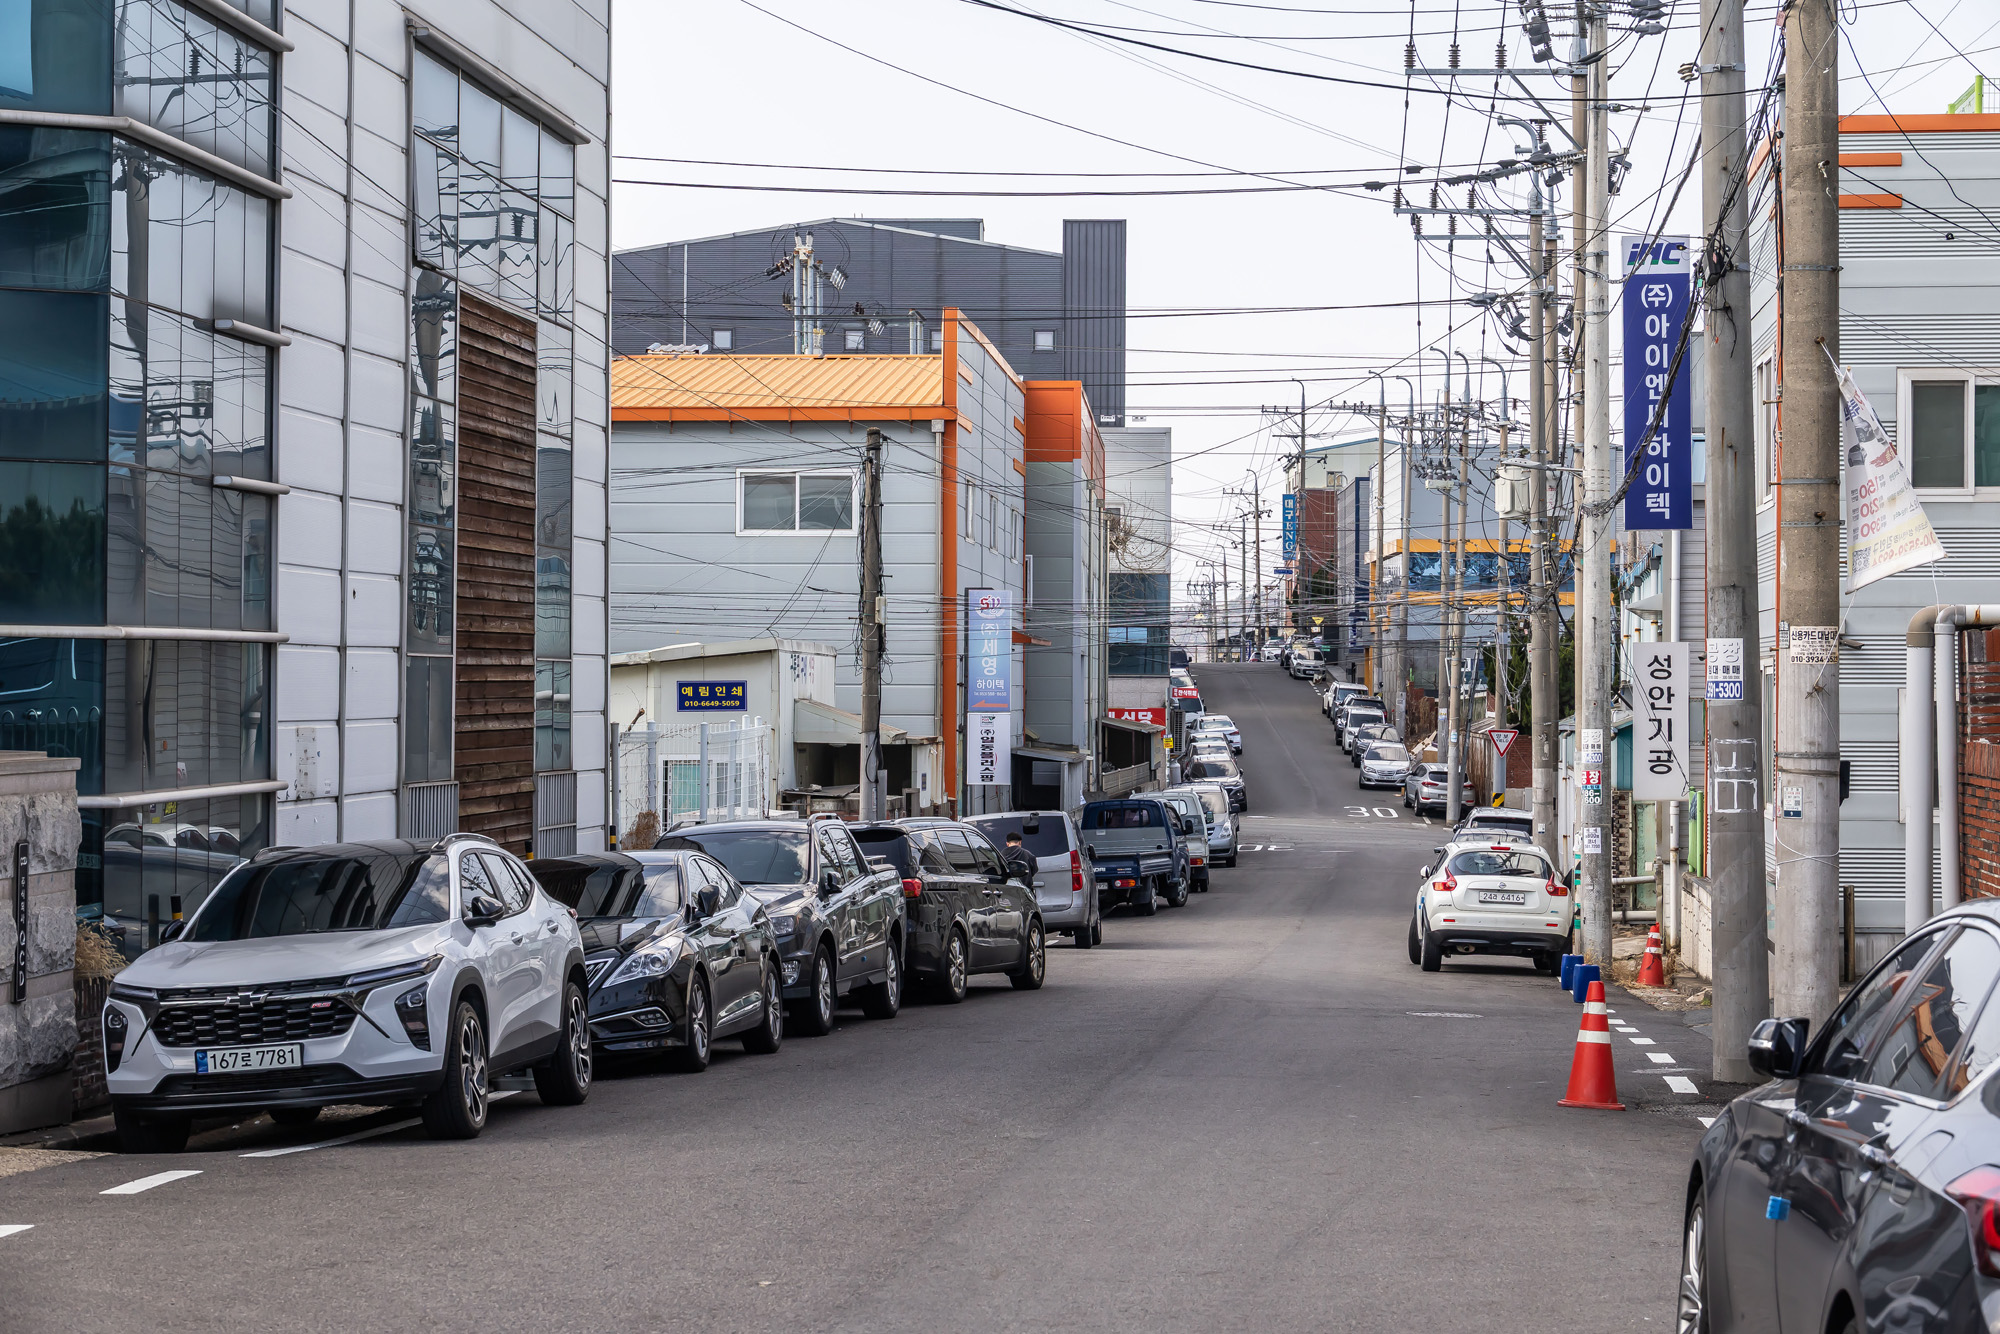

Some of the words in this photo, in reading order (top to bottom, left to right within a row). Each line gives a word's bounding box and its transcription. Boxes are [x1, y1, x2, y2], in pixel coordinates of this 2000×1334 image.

[976, 679, 1004, 690] 하이텍
[1647, 654, 1675, 775] 성안기공
[1344, 806, 1399, 818] 30
[209, 1052, 252, 1070] 167로
[256, 1048, 295, 1067] 7781
